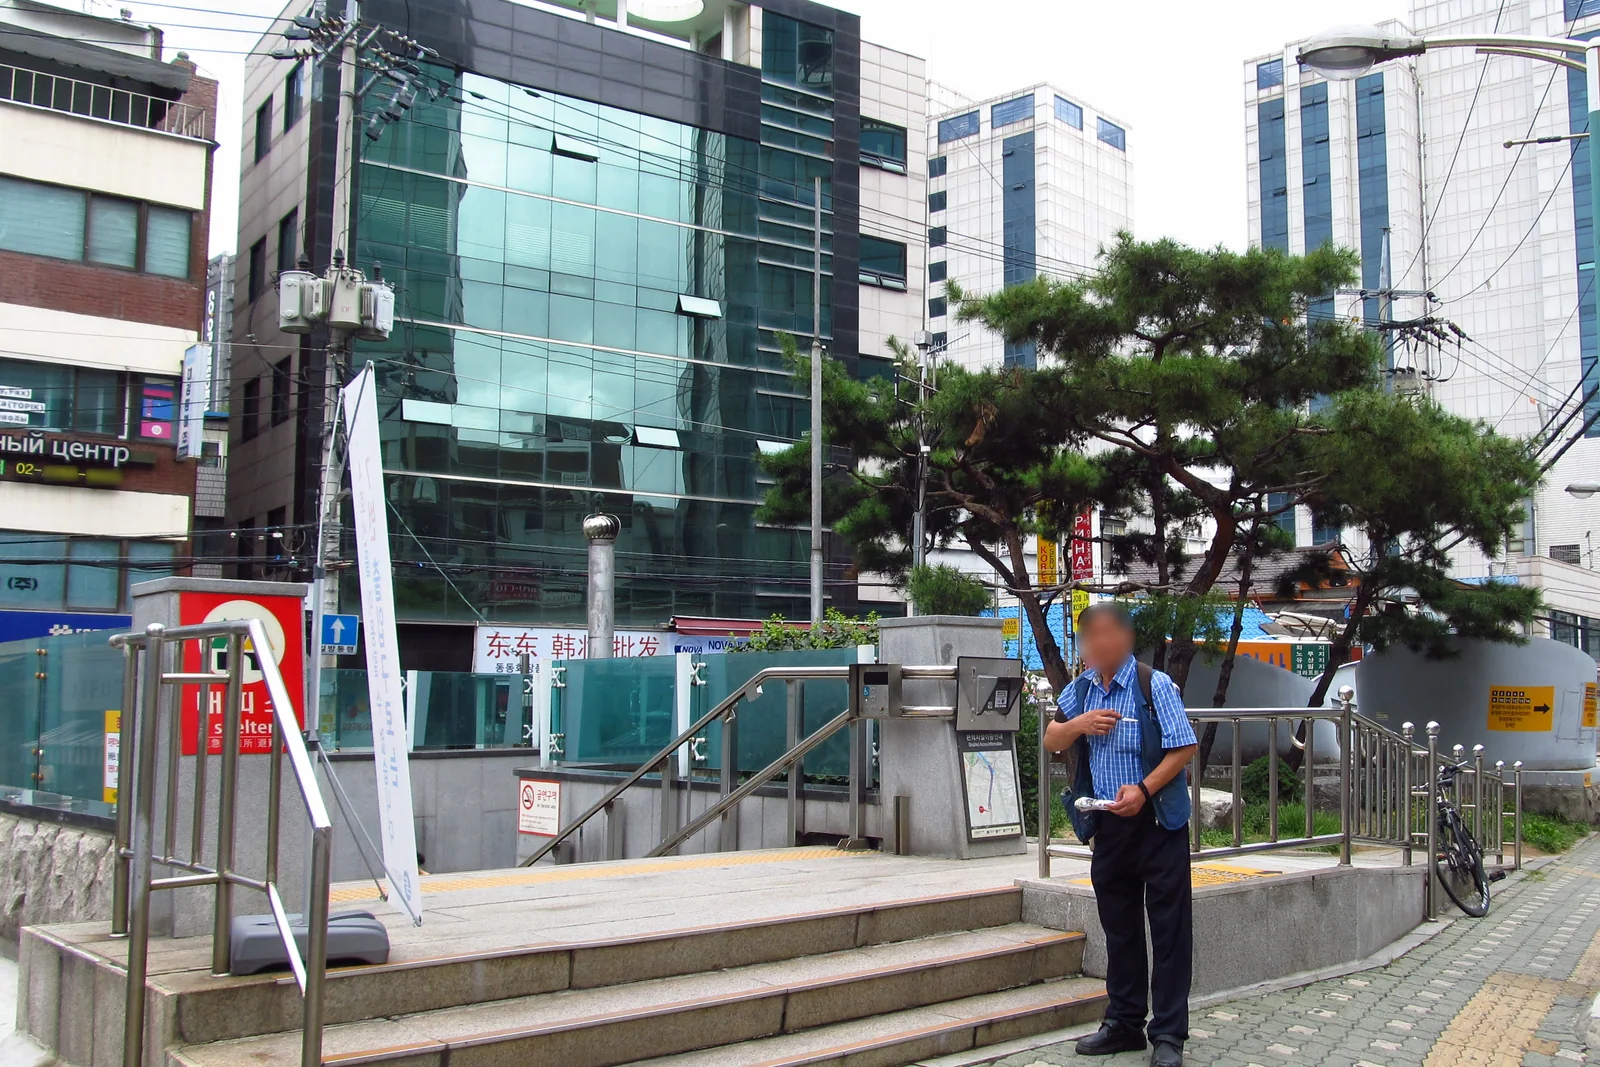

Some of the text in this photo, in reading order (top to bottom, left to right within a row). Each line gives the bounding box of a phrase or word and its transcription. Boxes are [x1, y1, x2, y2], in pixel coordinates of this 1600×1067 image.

[52, 440, 130, 467] центр
[214, 719, 272, 734] selter
[537, 789, 556, 802] 금연구역
